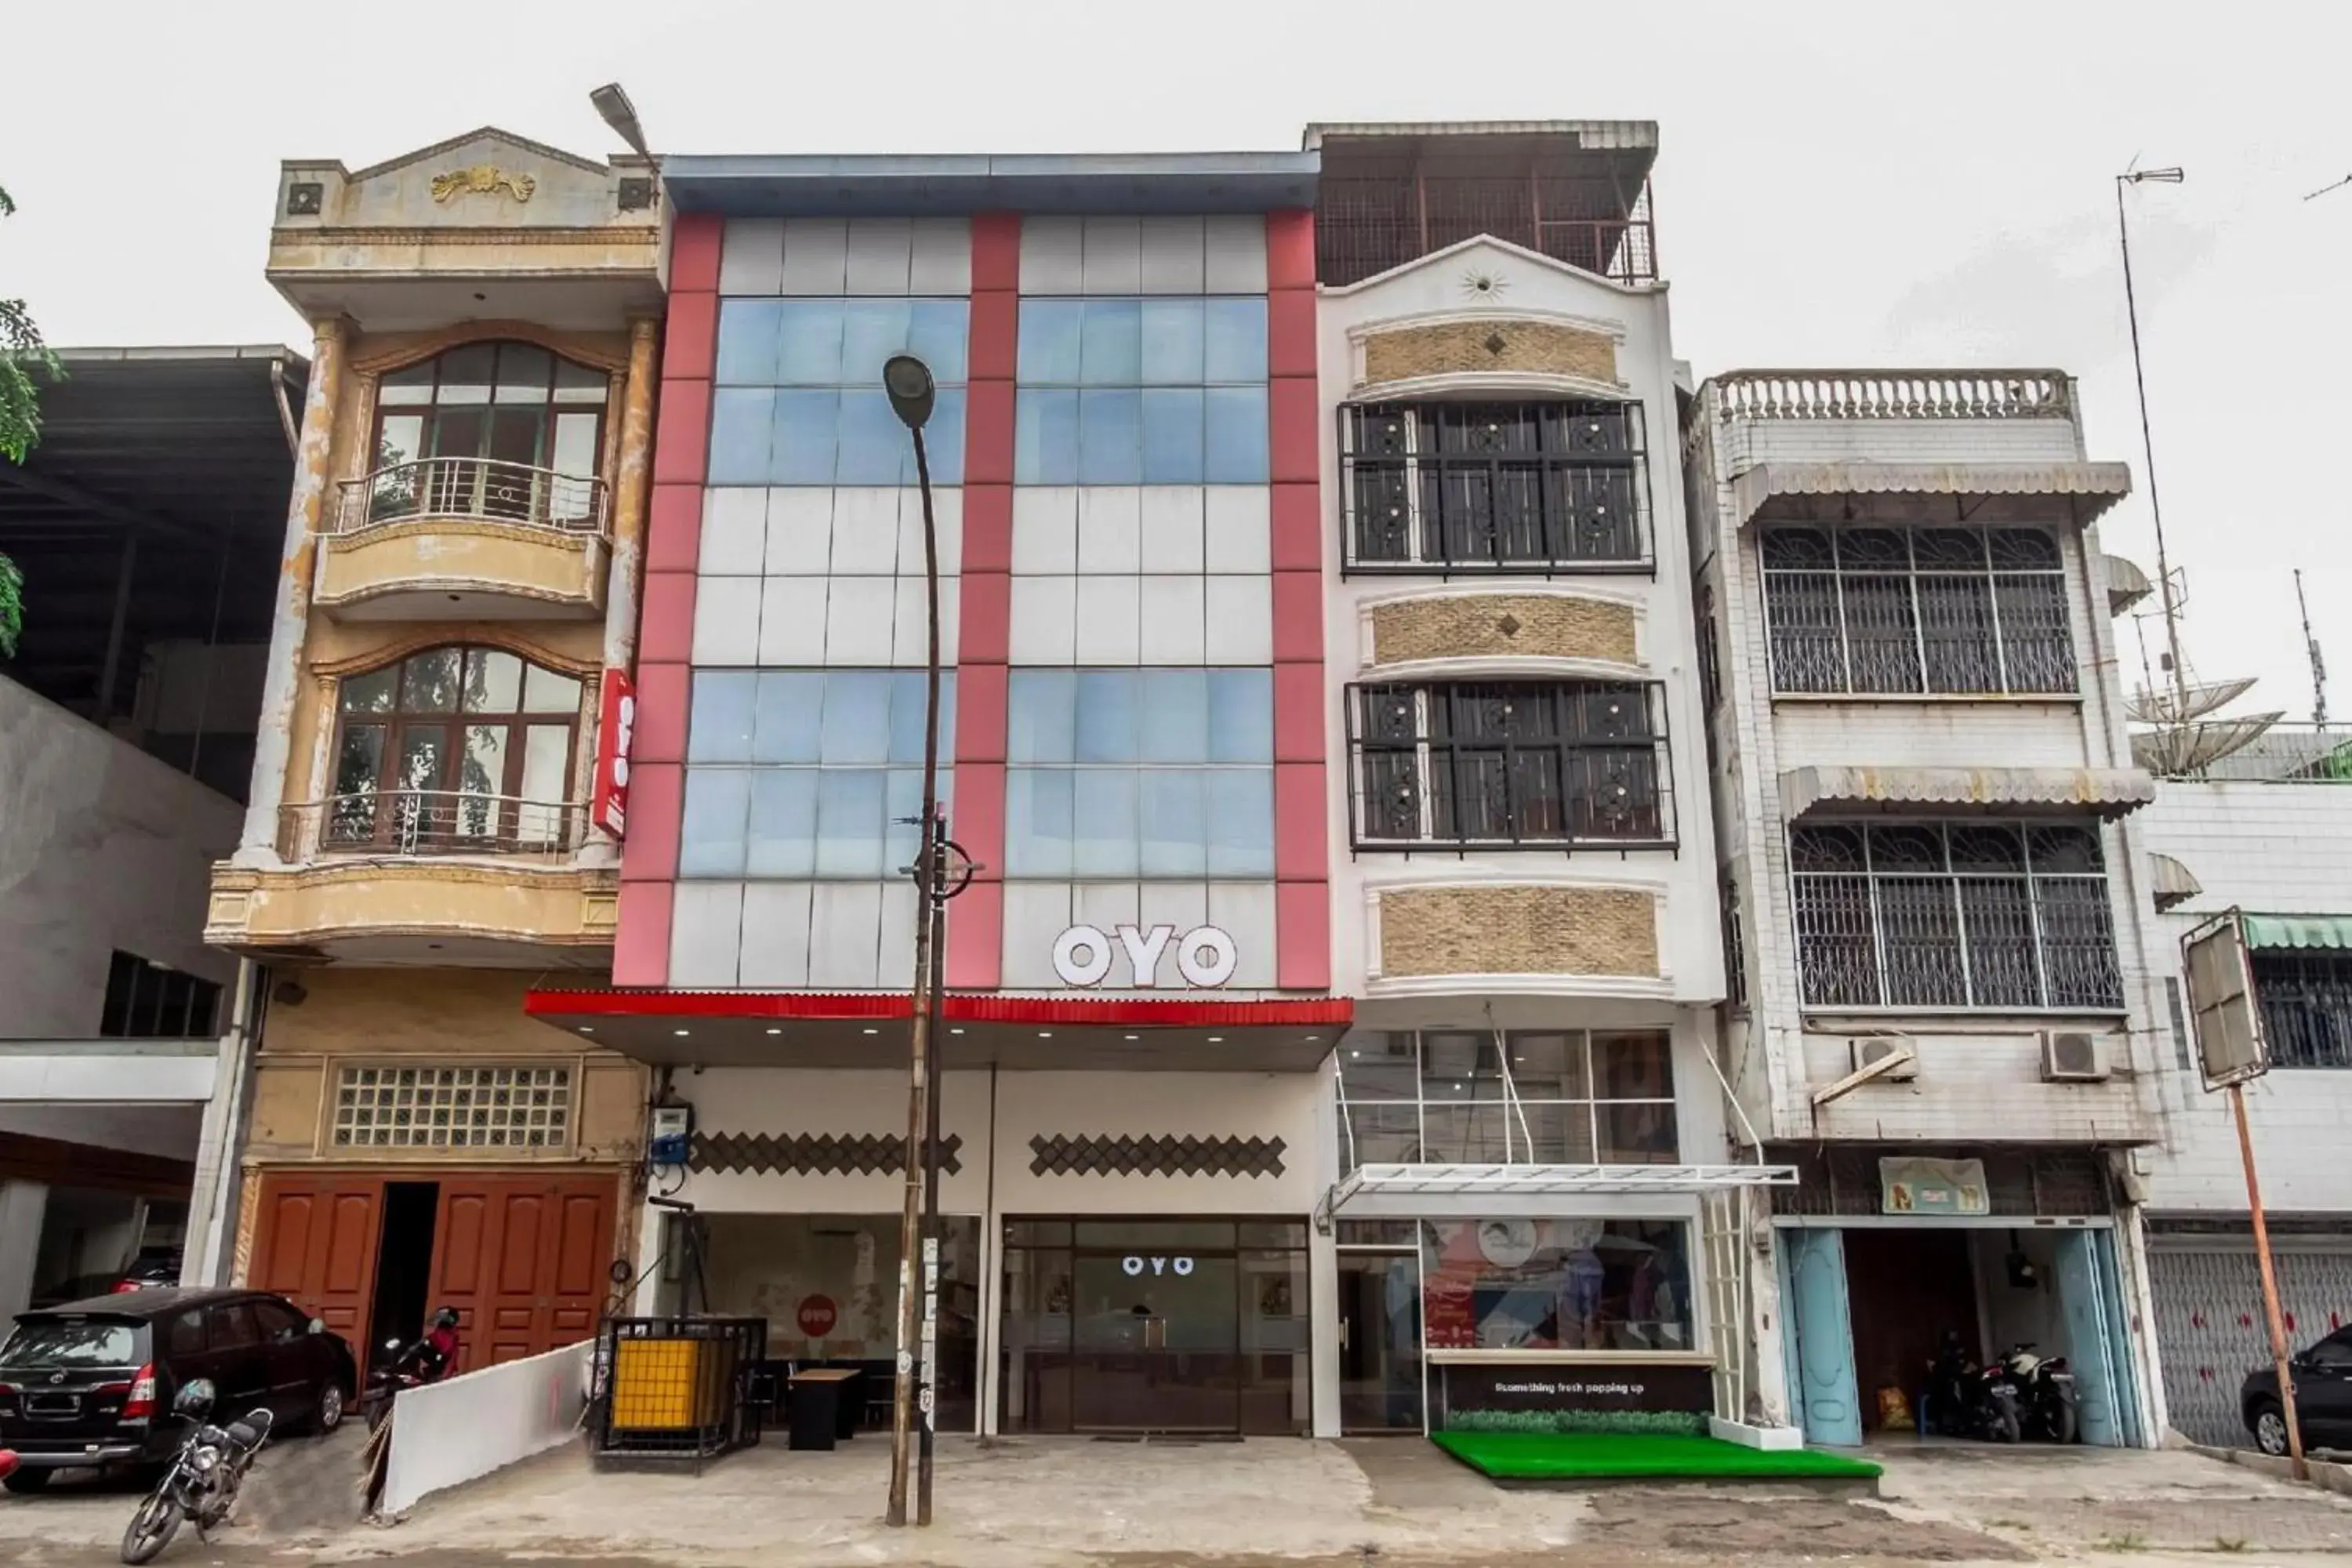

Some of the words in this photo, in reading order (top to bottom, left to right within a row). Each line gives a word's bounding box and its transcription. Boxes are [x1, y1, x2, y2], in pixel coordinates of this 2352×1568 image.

[1052, 924, 1237, 987] OYO
[1122, 1256, 1194, 1276] OYO
[800, 1308, 833, 1323] OYO
[1558, 1382, 1584, 1392] fresh
[1585, 1383, 1628, 1394] popping
[1631, 1385, 1644, 1394] up
